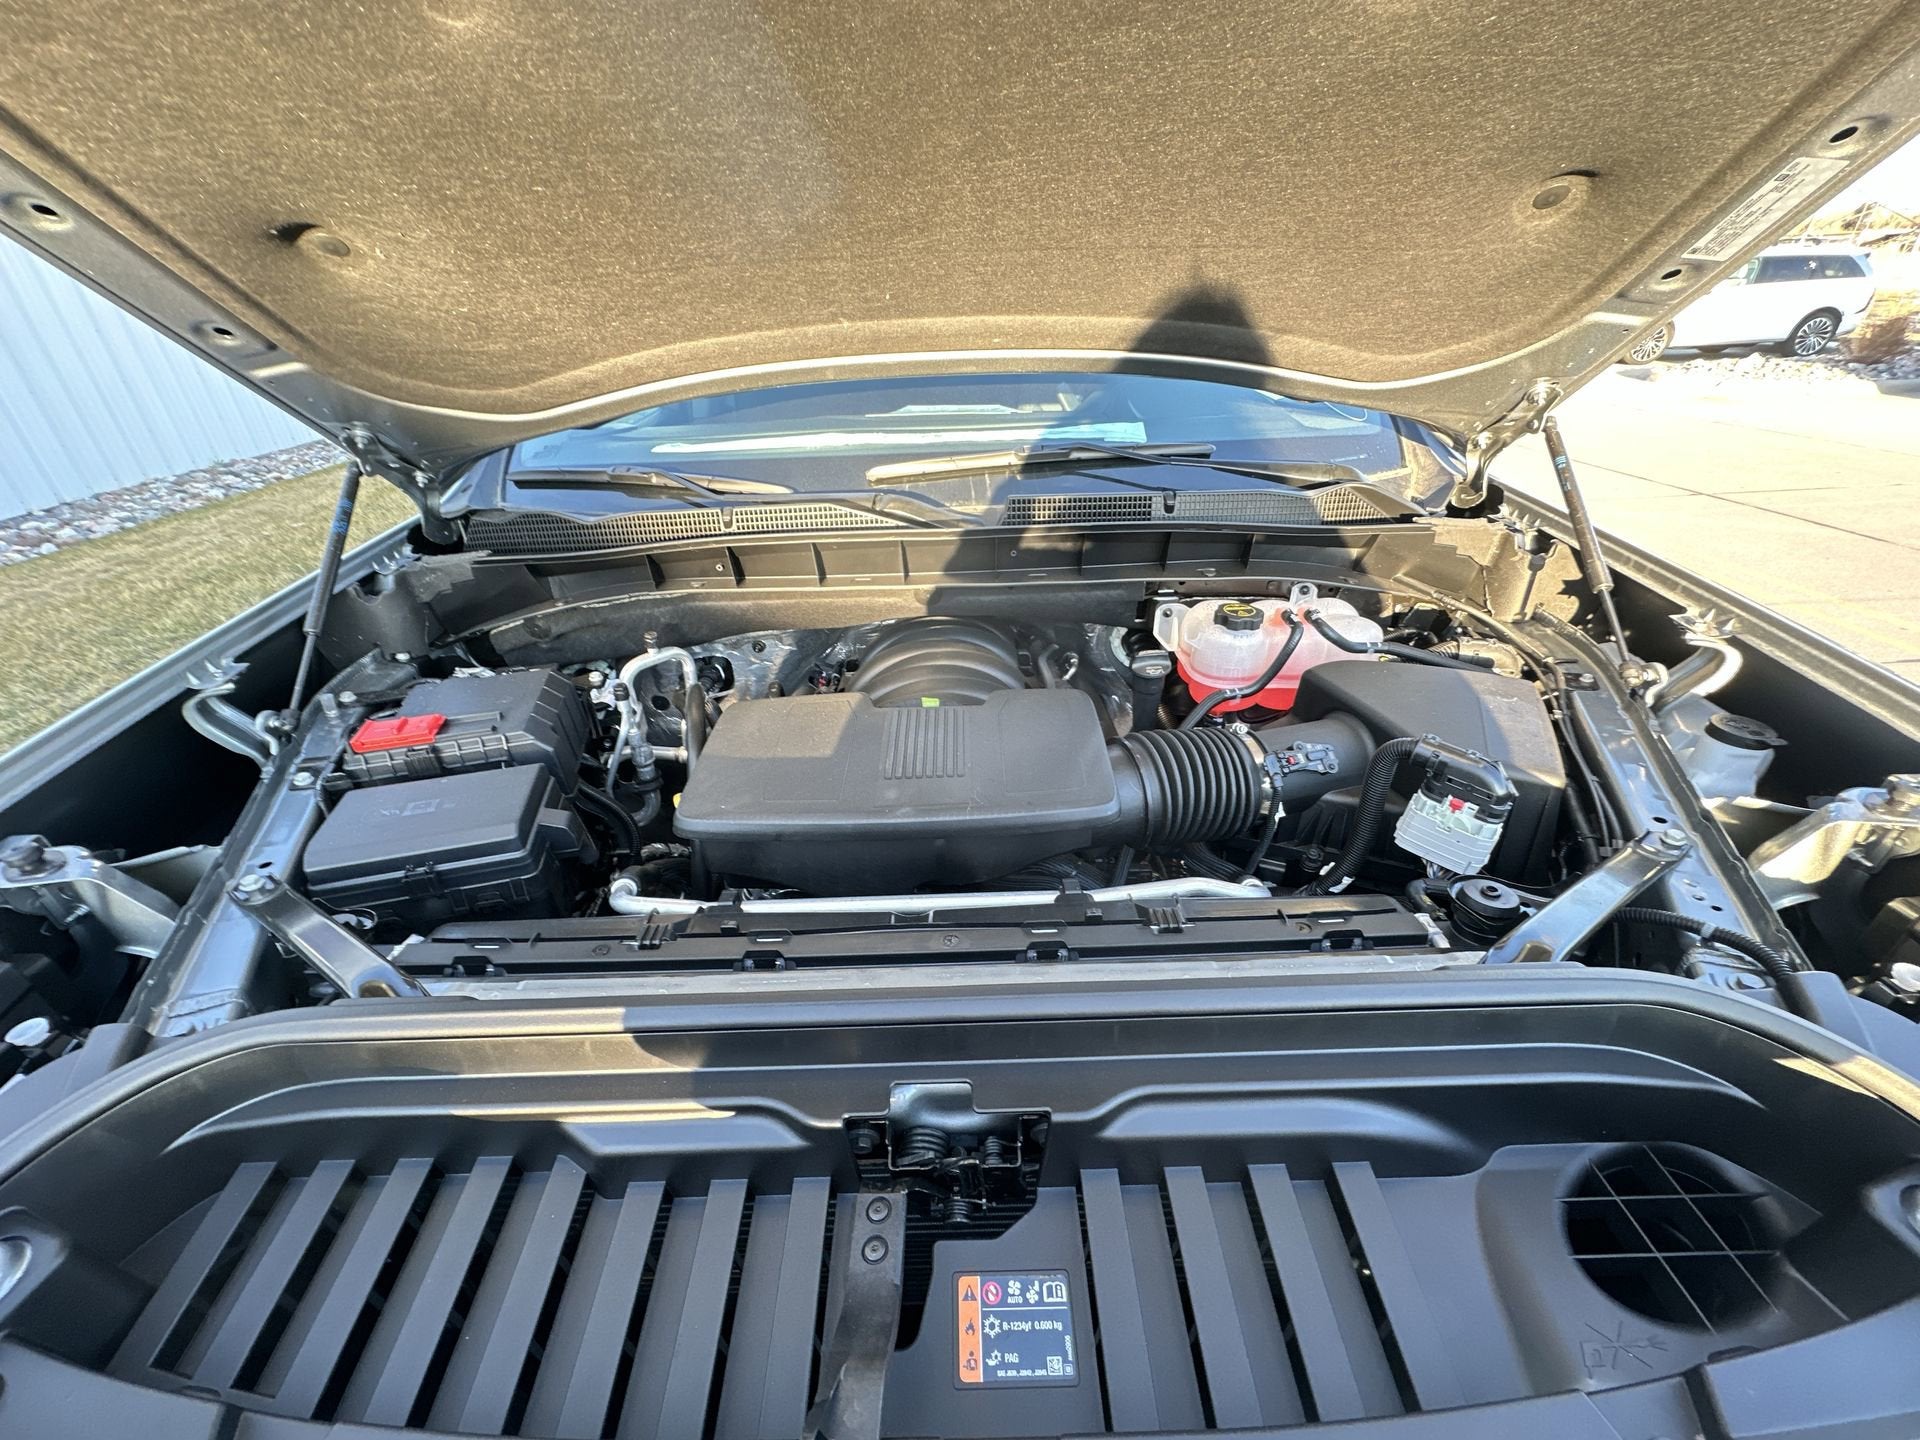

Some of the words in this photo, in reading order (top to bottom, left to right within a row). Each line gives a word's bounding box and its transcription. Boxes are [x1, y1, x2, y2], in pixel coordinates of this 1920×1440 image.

[1007, 1295, 1023, 1304] AUTO
[1053, 1320, 1063, 1331] kg
[1004, 1352, 1019, 1364] PAG
